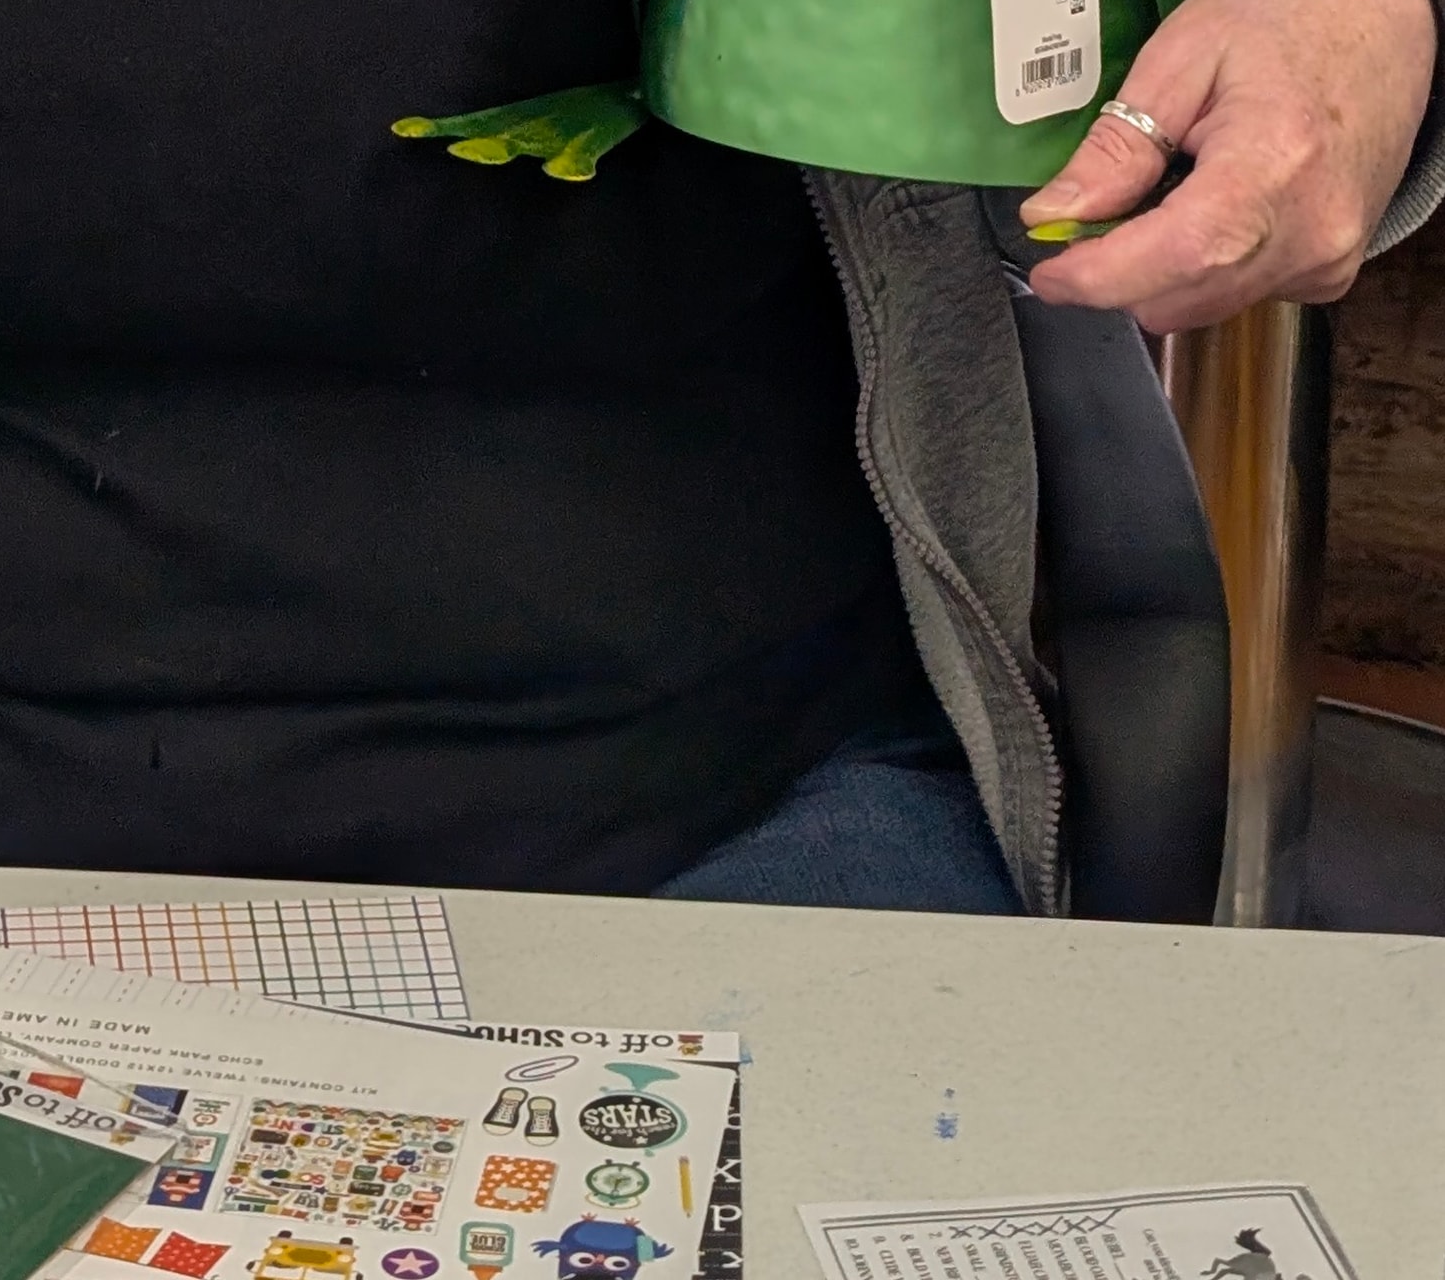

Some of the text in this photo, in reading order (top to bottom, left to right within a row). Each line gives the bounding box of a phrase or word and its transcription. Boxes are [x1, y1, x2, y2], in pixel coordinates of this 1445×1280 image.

[56, 1016, 78, 1028] IN
[89, 1019, 151, 1035] MADE
[571, 1031, 610, 1048] to
[619, 1033, 674, 1053] off
[109, 1042, 162, 1056] PAPER
[169, 1048, 211, 1061] PARK
[56, 1053, 121, 1069] DOUBLE
[217, 1054, 264, 1066] ECHO
[182, 1068, 247, 1082] TWELVE
[351, 1086, 379, 1096] KIT
[24, 1092, 60, 1116] to
[56, 1106, 117, 1132] off
[583, 1104, 673, 1128] STARS
